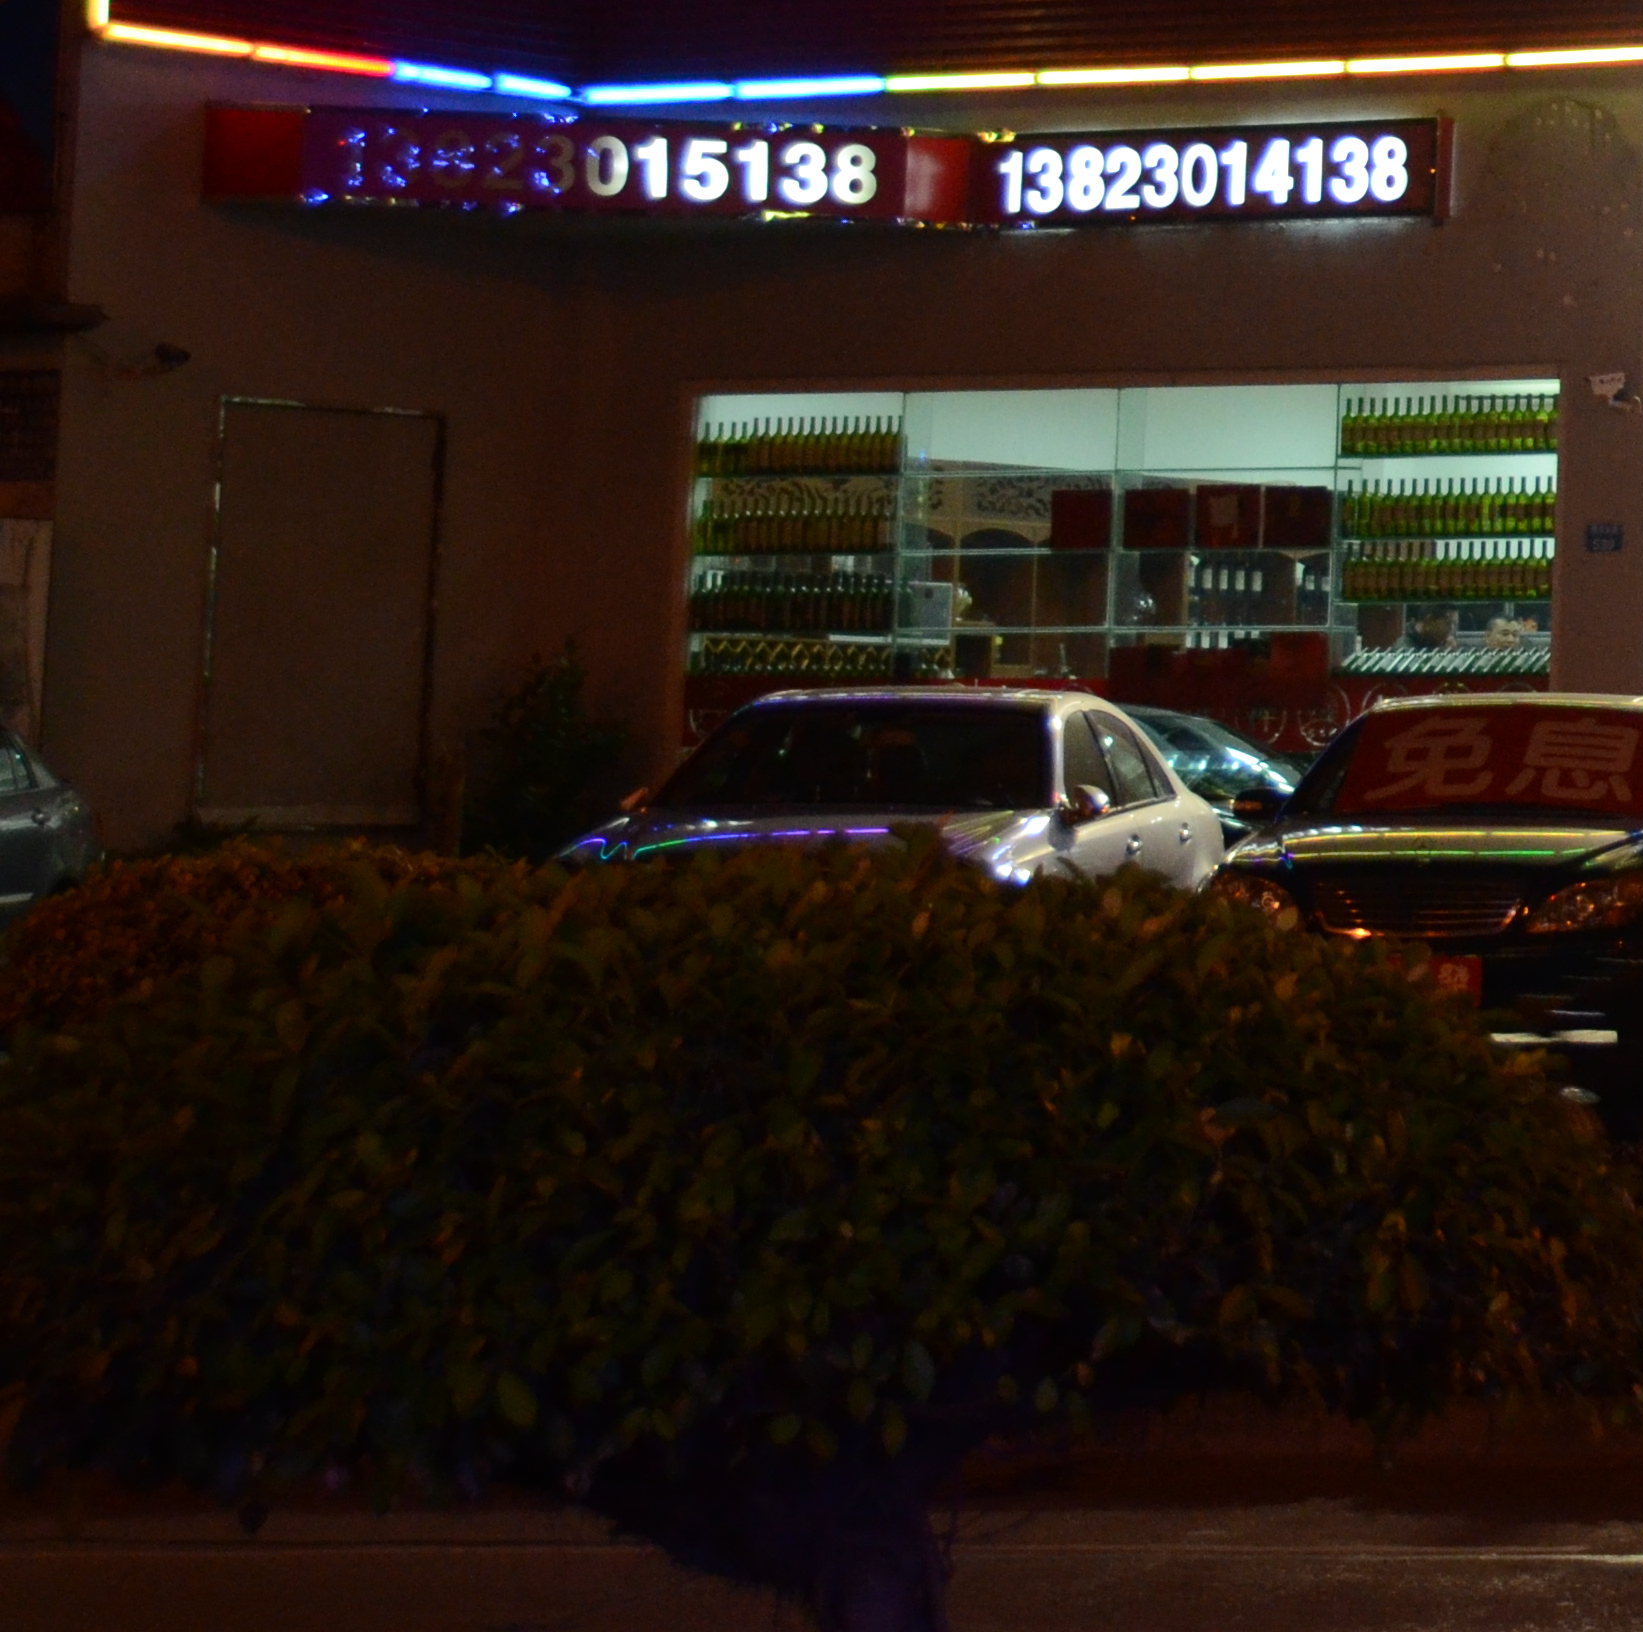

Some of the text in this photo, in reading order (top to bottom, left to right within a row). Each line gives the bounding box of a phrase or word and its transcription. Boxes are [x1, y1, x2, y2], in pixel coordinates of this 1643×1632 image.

[338, 127, 880, 207] 13823015138
[997, 135, 1410, 216] 13823014138
[1363, 714, 1642, 803] 免息
